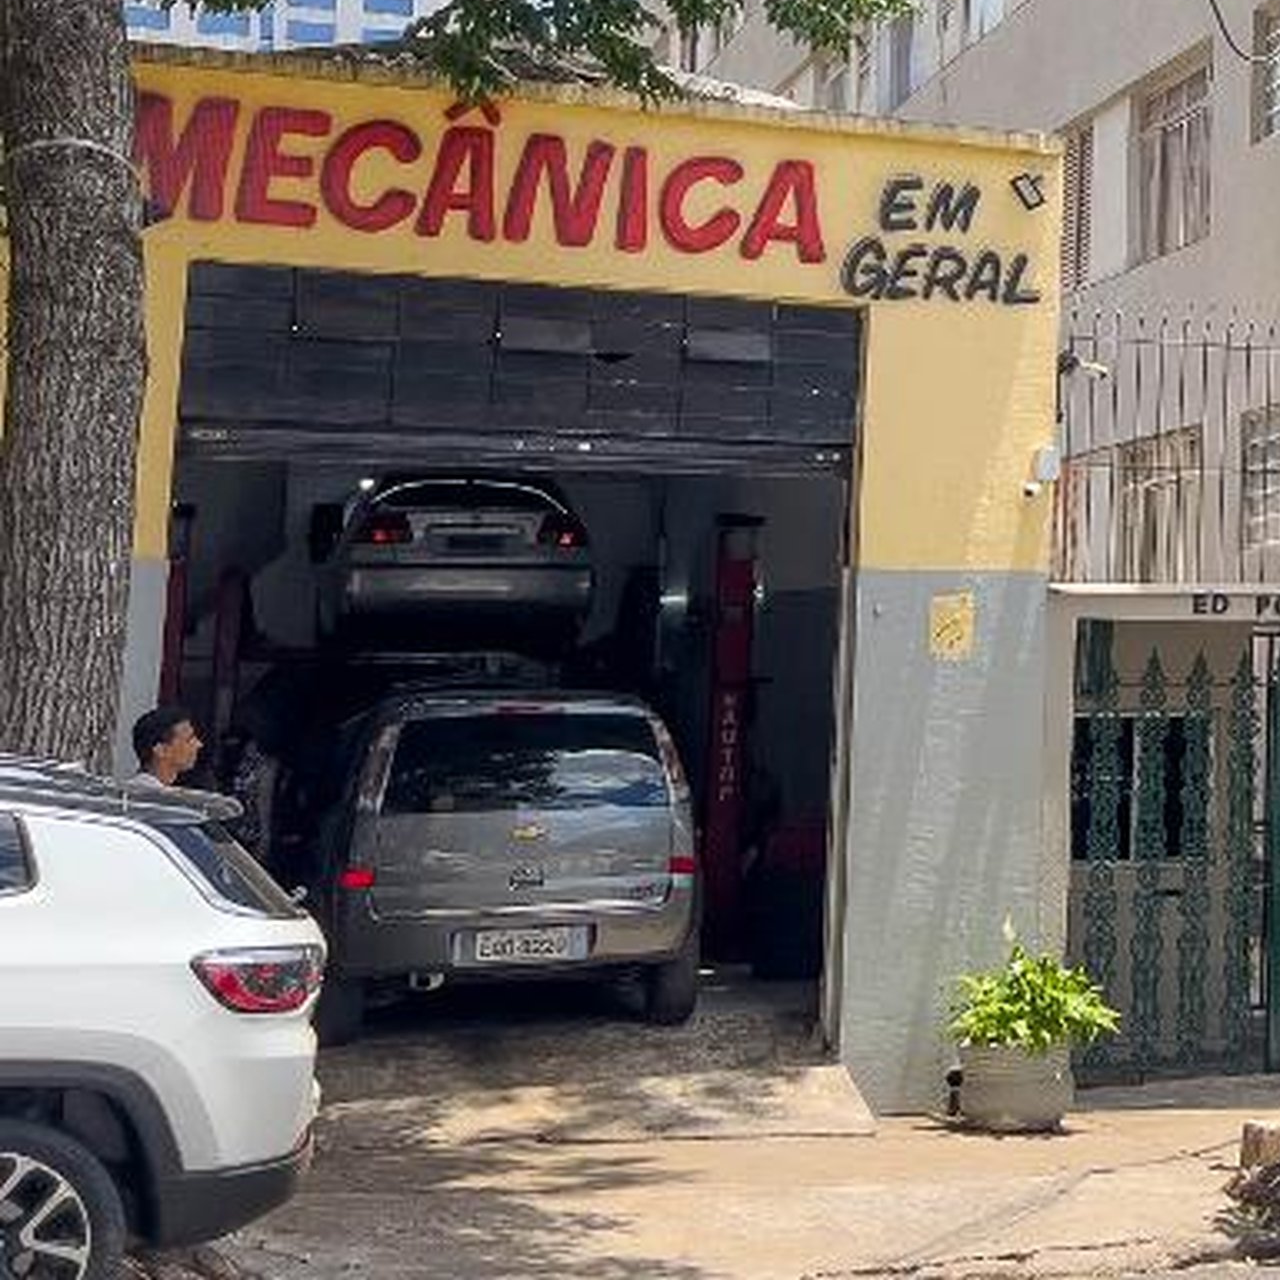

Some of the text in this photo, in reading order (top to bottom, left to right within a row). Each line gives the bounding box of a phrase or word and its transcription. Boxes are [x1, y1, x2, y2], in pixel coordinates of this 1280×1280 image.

[133, 91, 826, 265] MECÂNICA
[880, 174, 981, 234] EM
[840, 236, 1041, 304] GERAL
[1192, 592, 1230, 616] ED
